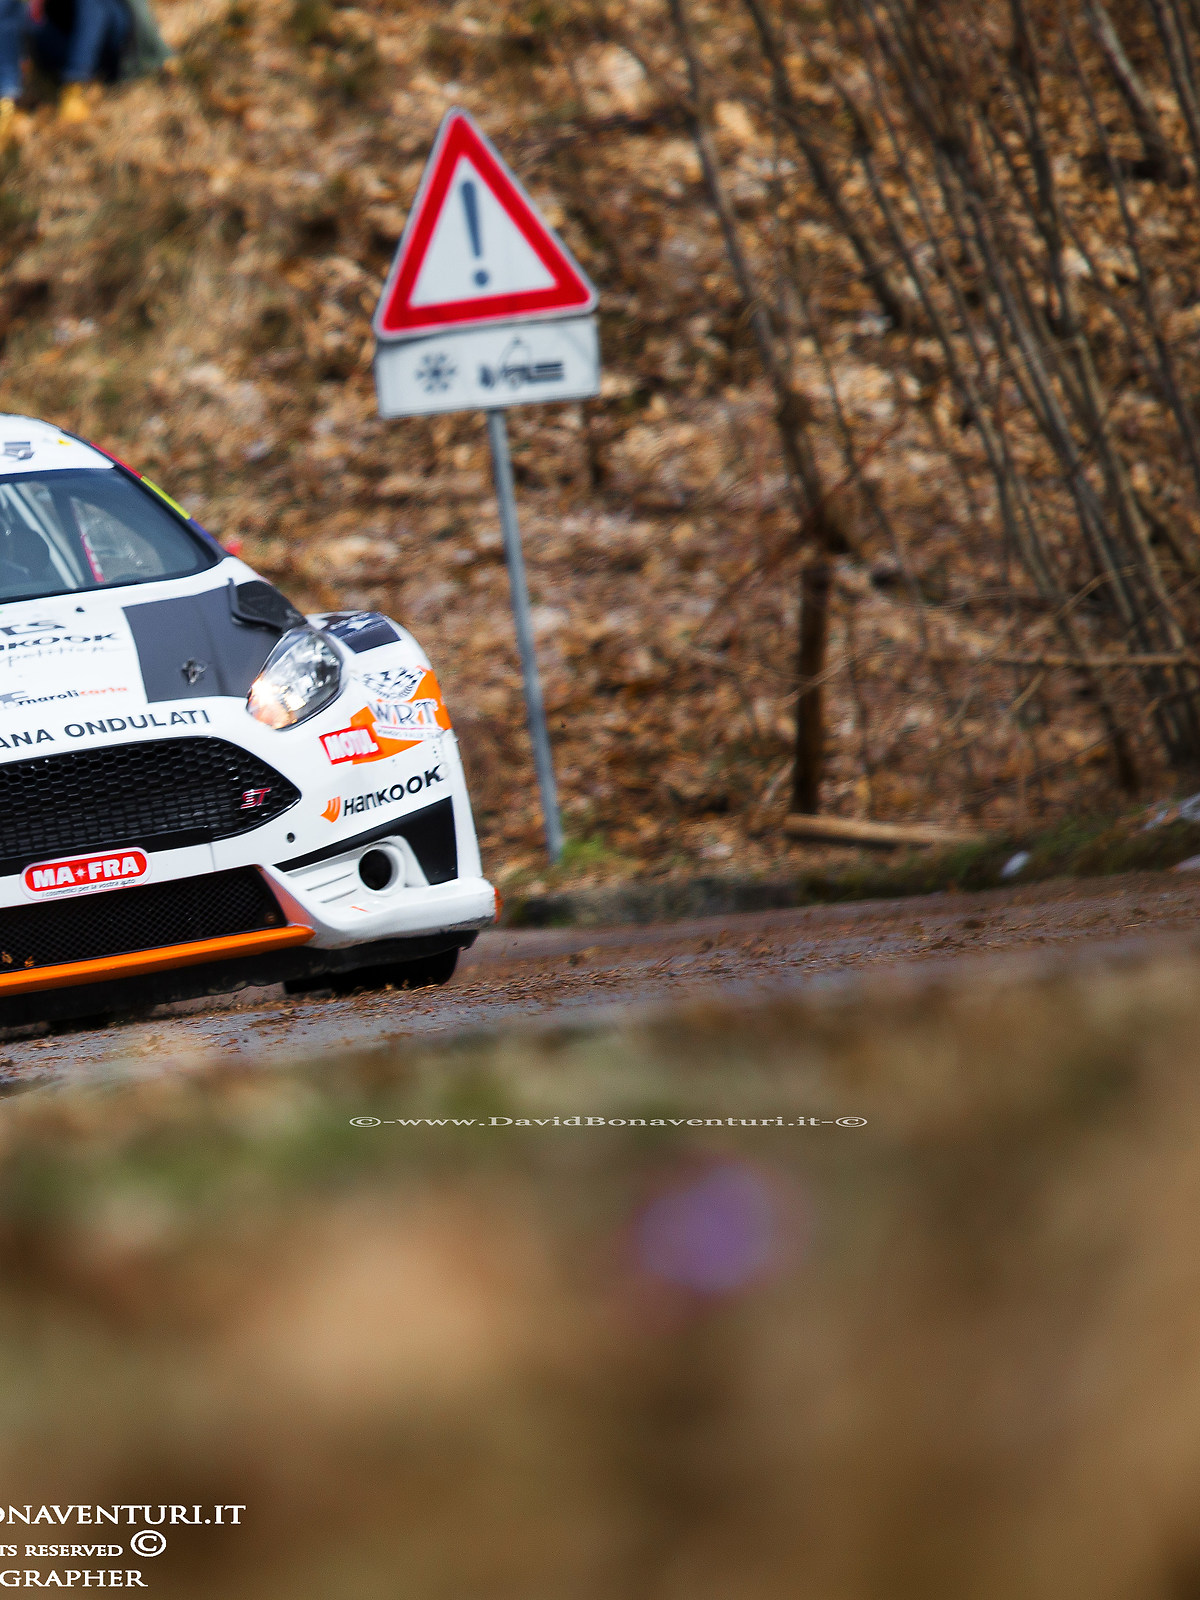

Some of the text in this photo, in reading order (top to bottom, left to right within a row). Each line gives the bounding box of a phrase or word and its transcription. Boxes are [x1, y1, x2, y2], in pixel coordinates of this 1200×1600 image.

[64, 709, 211, 739] ONDULATI
[367, 700, 439, 726] WRT
[323, 728, 379, 761] MOTUL
[240, 787, 272, 810] ST
